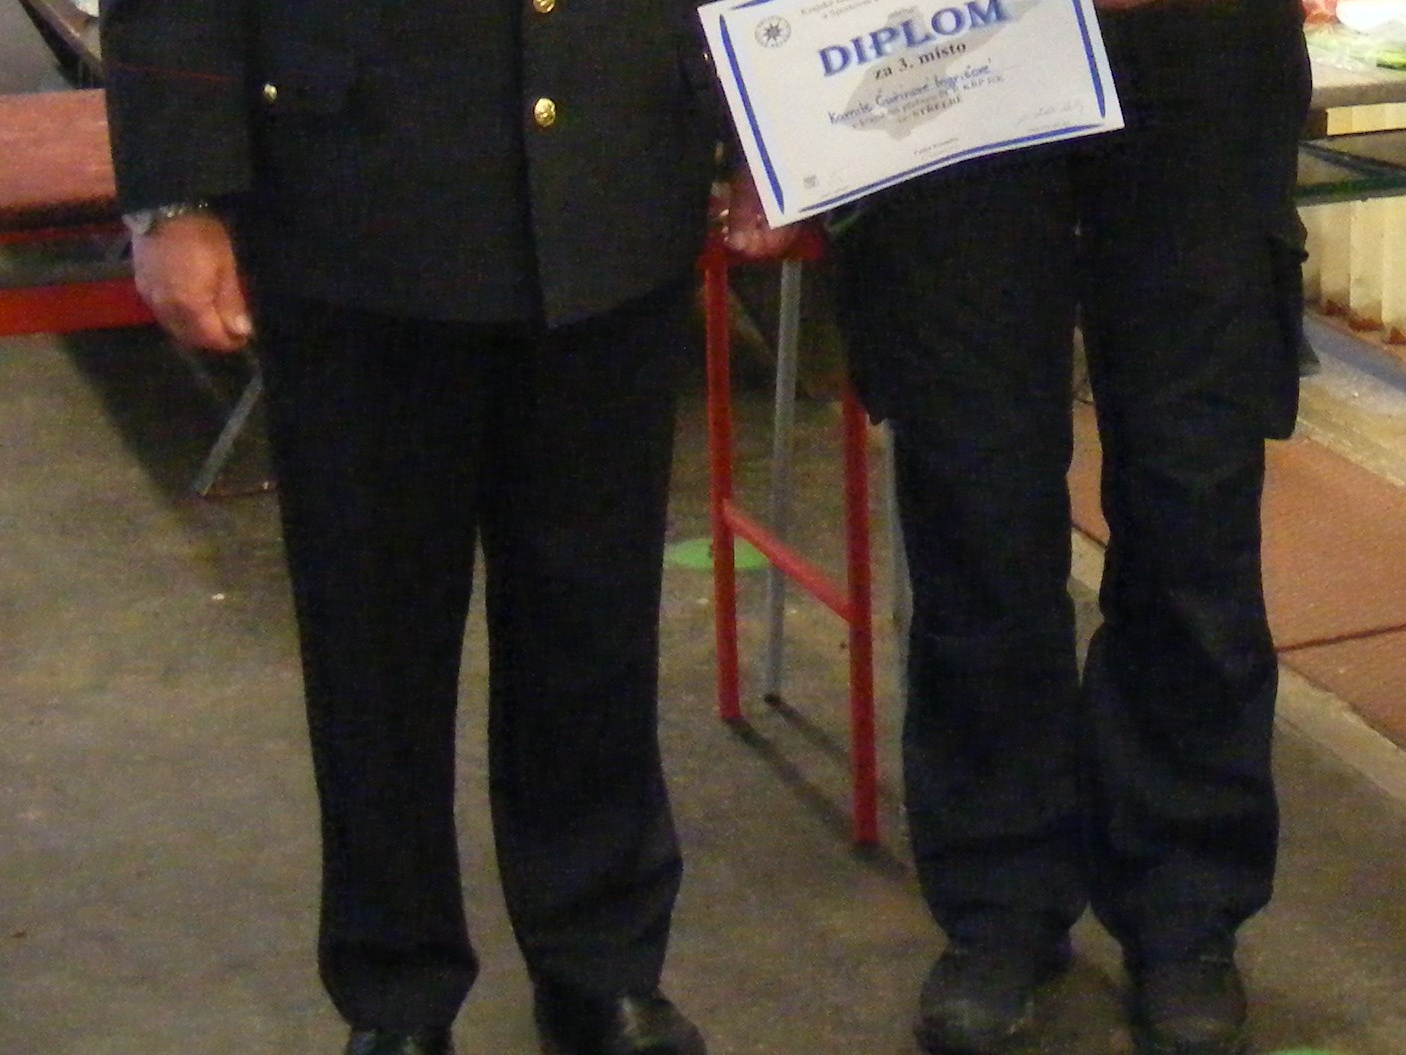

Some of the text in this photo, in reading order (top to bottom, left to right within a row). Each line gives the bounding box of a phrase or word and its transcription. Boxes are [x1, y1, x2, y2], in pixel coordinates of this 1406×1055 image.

[874, 41, 967, 81] za 3. místo
